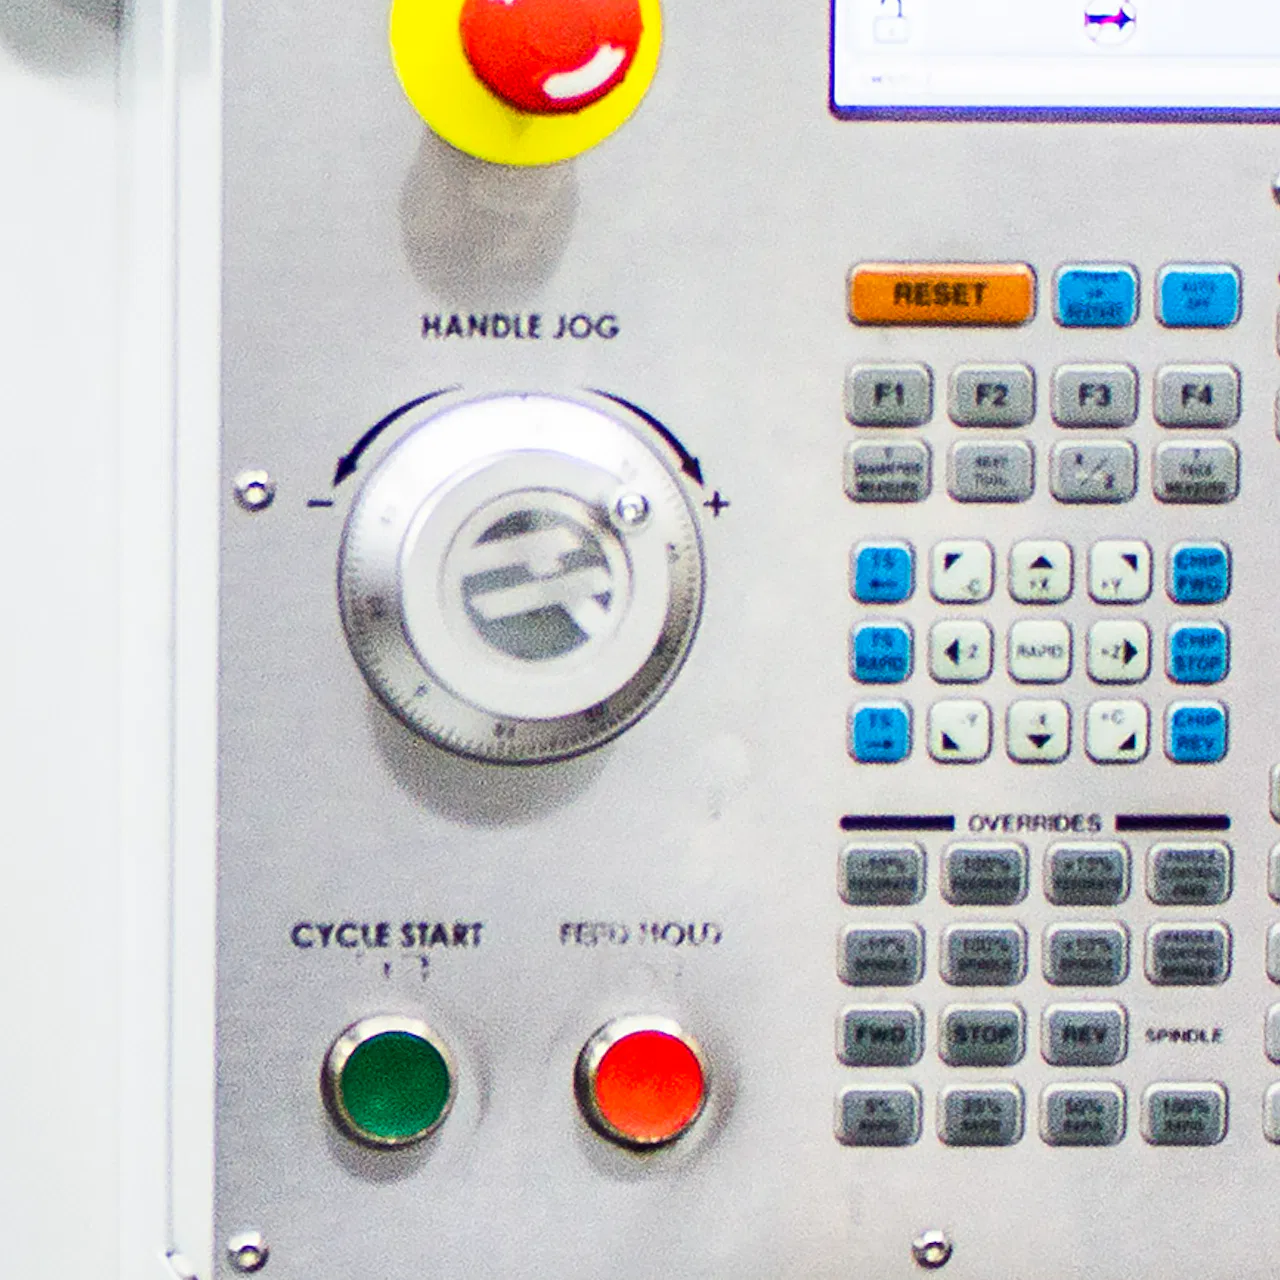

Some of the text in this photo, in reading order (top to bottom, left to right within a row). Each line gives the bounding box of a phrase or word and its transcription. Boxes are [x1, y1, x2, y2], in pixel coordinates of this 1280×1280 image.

[892, 281, 989, 307] RESET
[420, 314, 620, 340] HANDLE JOG
[873, 382, 905, 407] F1
[975, 382, 1009, 407] F2
[1078, 382, 1112, 407] F3
[1181, 382, 1213, 407] F4
[968, 813, 1103, 834] OVERRIDES
[290, 921, 485, 949] CYCLE START
[953, 1026, 1012, 1043] STOP
[1061, 1026, 1107, 1044] REV
[1144, 1027, 1224, 1045] SPINDLE
